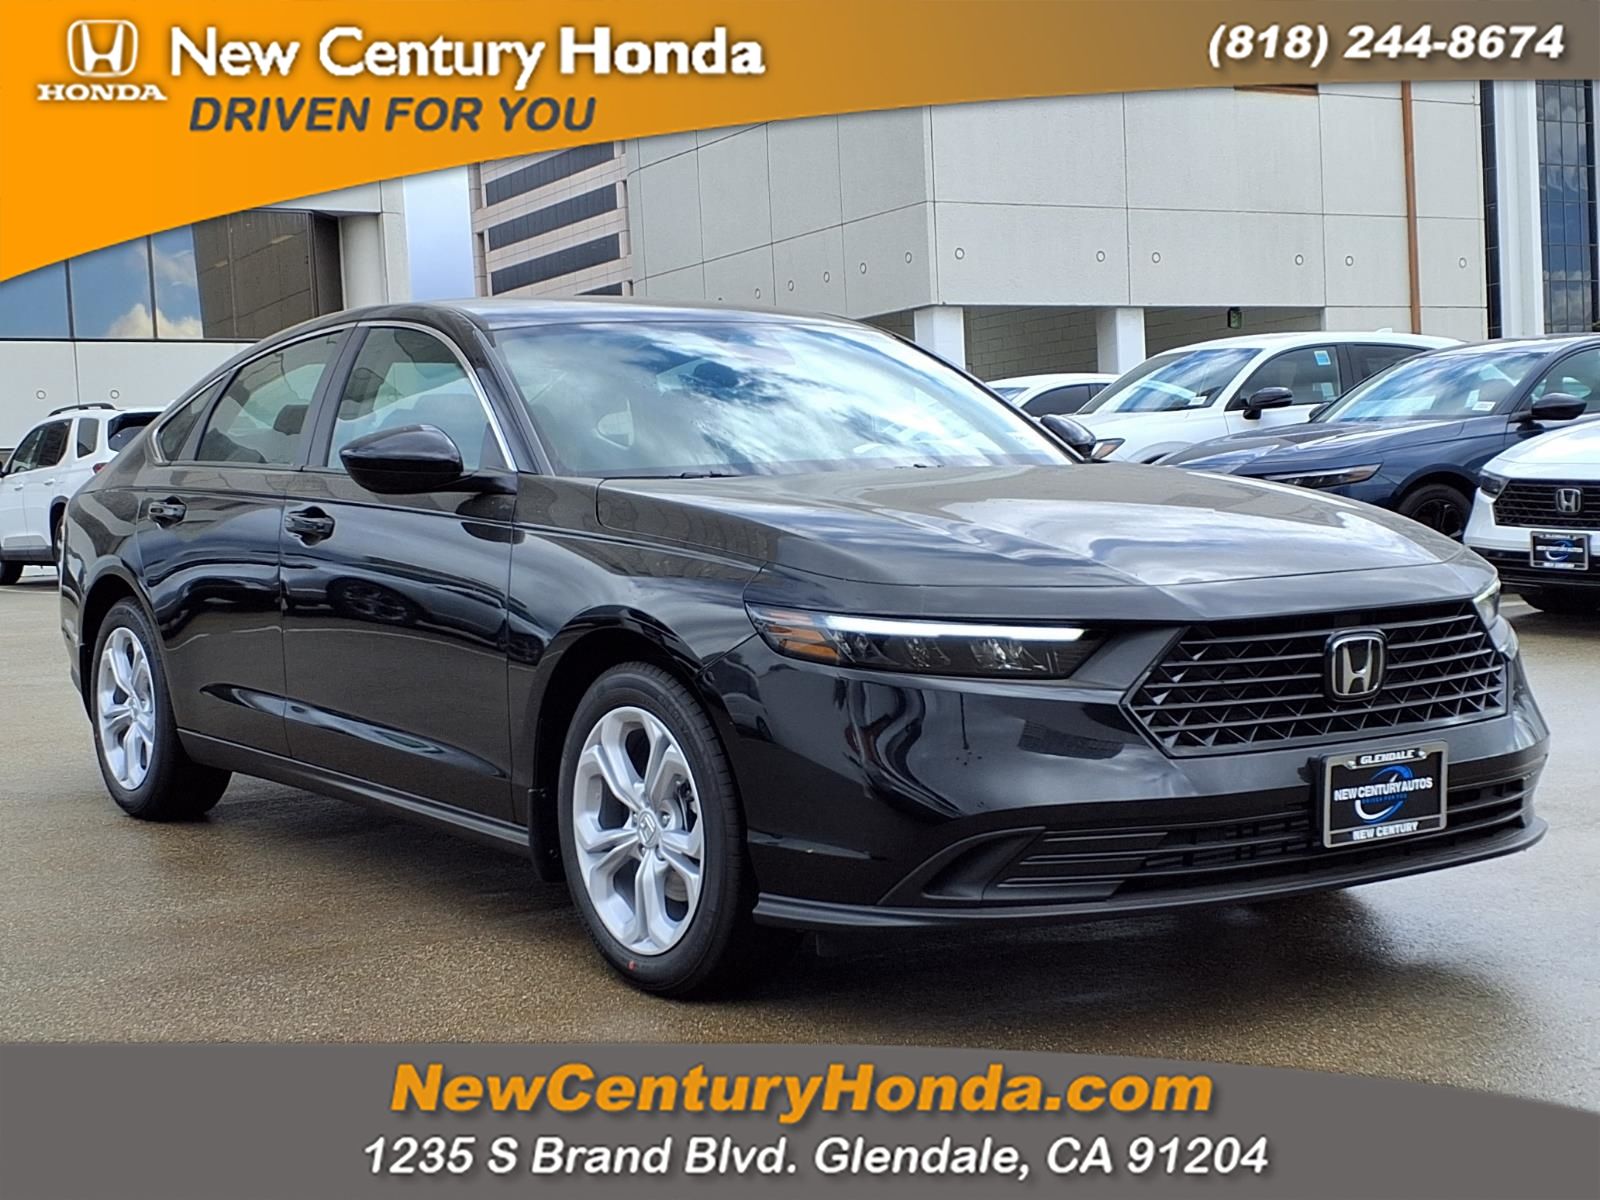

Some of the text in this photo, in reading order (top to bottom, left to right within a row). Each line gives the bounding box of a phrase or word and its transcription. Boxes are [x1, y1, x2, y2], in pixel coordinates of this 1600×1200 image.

[1360, 749, 1414, 764] GLENDALE
[1333, 786, 1358, 801] NEW
[1357, 781, 1402, 798] CENTURY
[1402, 777, 1433, 792] AUTOS
[1352, 822, 1418, 841] NEW CENTURY
